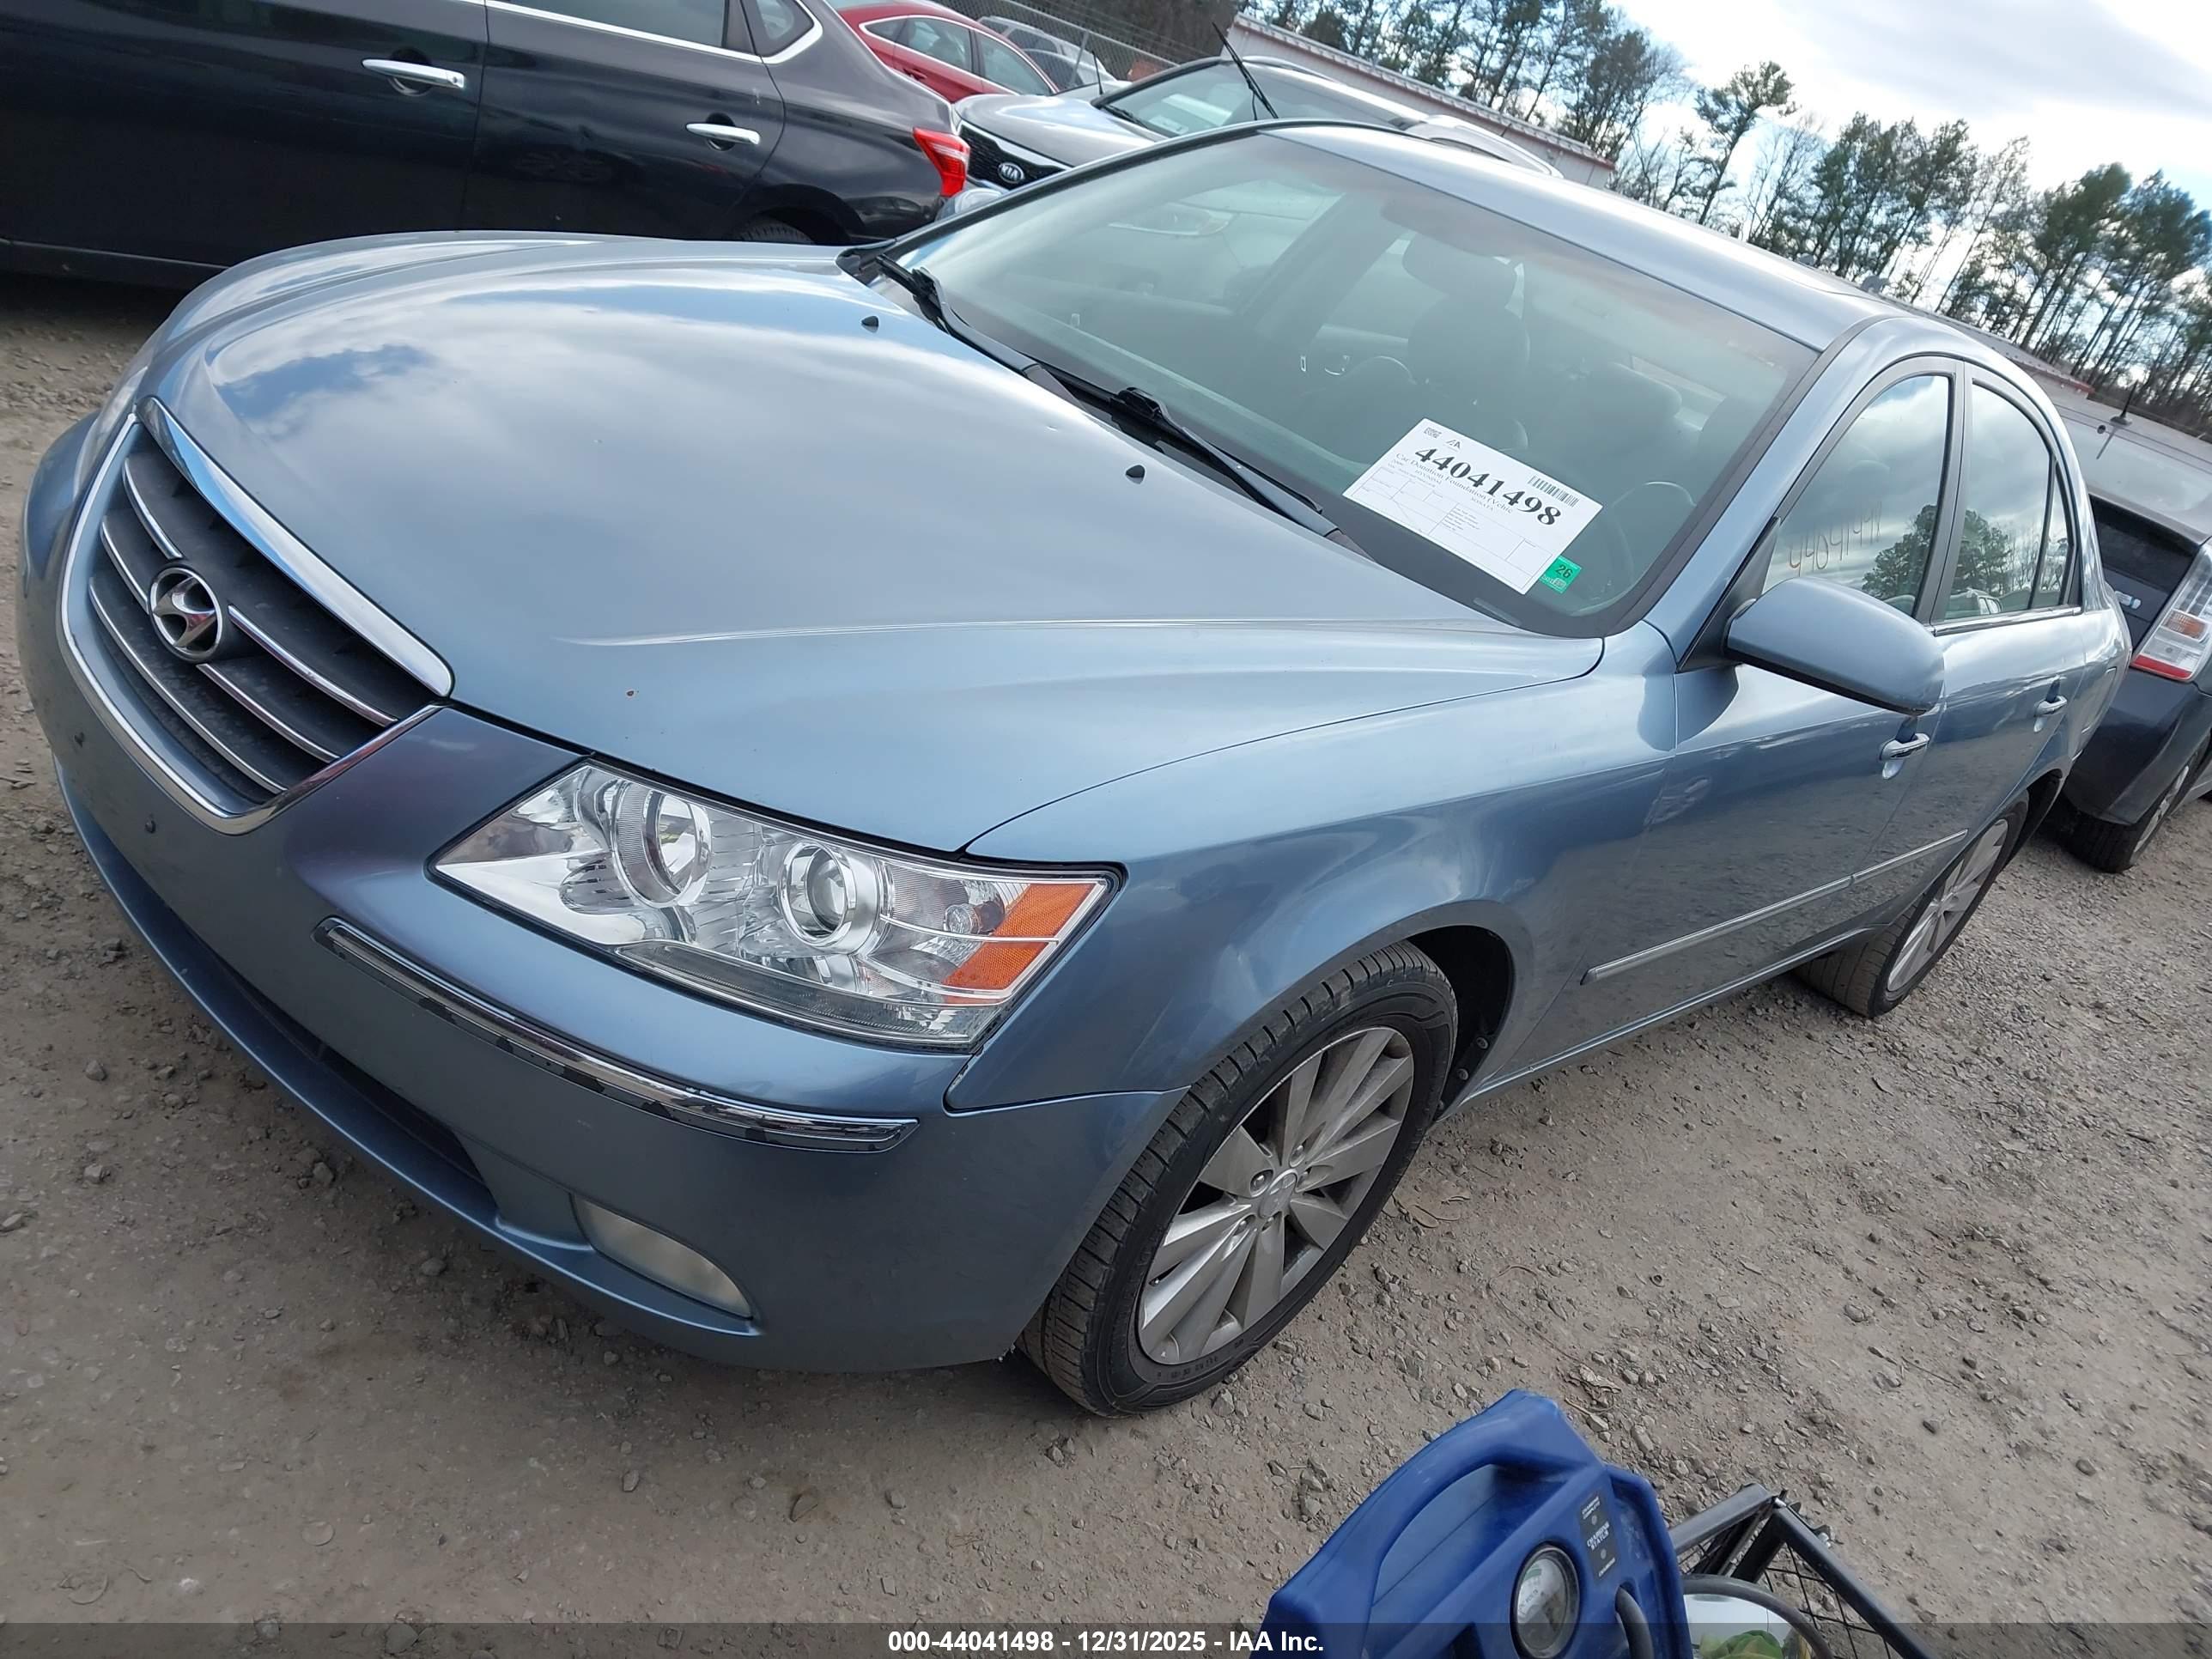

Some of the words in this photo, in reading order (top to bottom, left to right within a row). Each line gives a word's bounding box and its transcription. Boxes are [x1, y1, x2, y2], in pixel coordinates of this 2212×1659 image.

[1396, 453, 1409, 462] Car
[1410, 459, 1443, 478] Donation
[1444, 476, 1486, 500] Foundation
[1415, 448, 1561, 526] 44041498
[1555, 564, 1573, 578] 26
